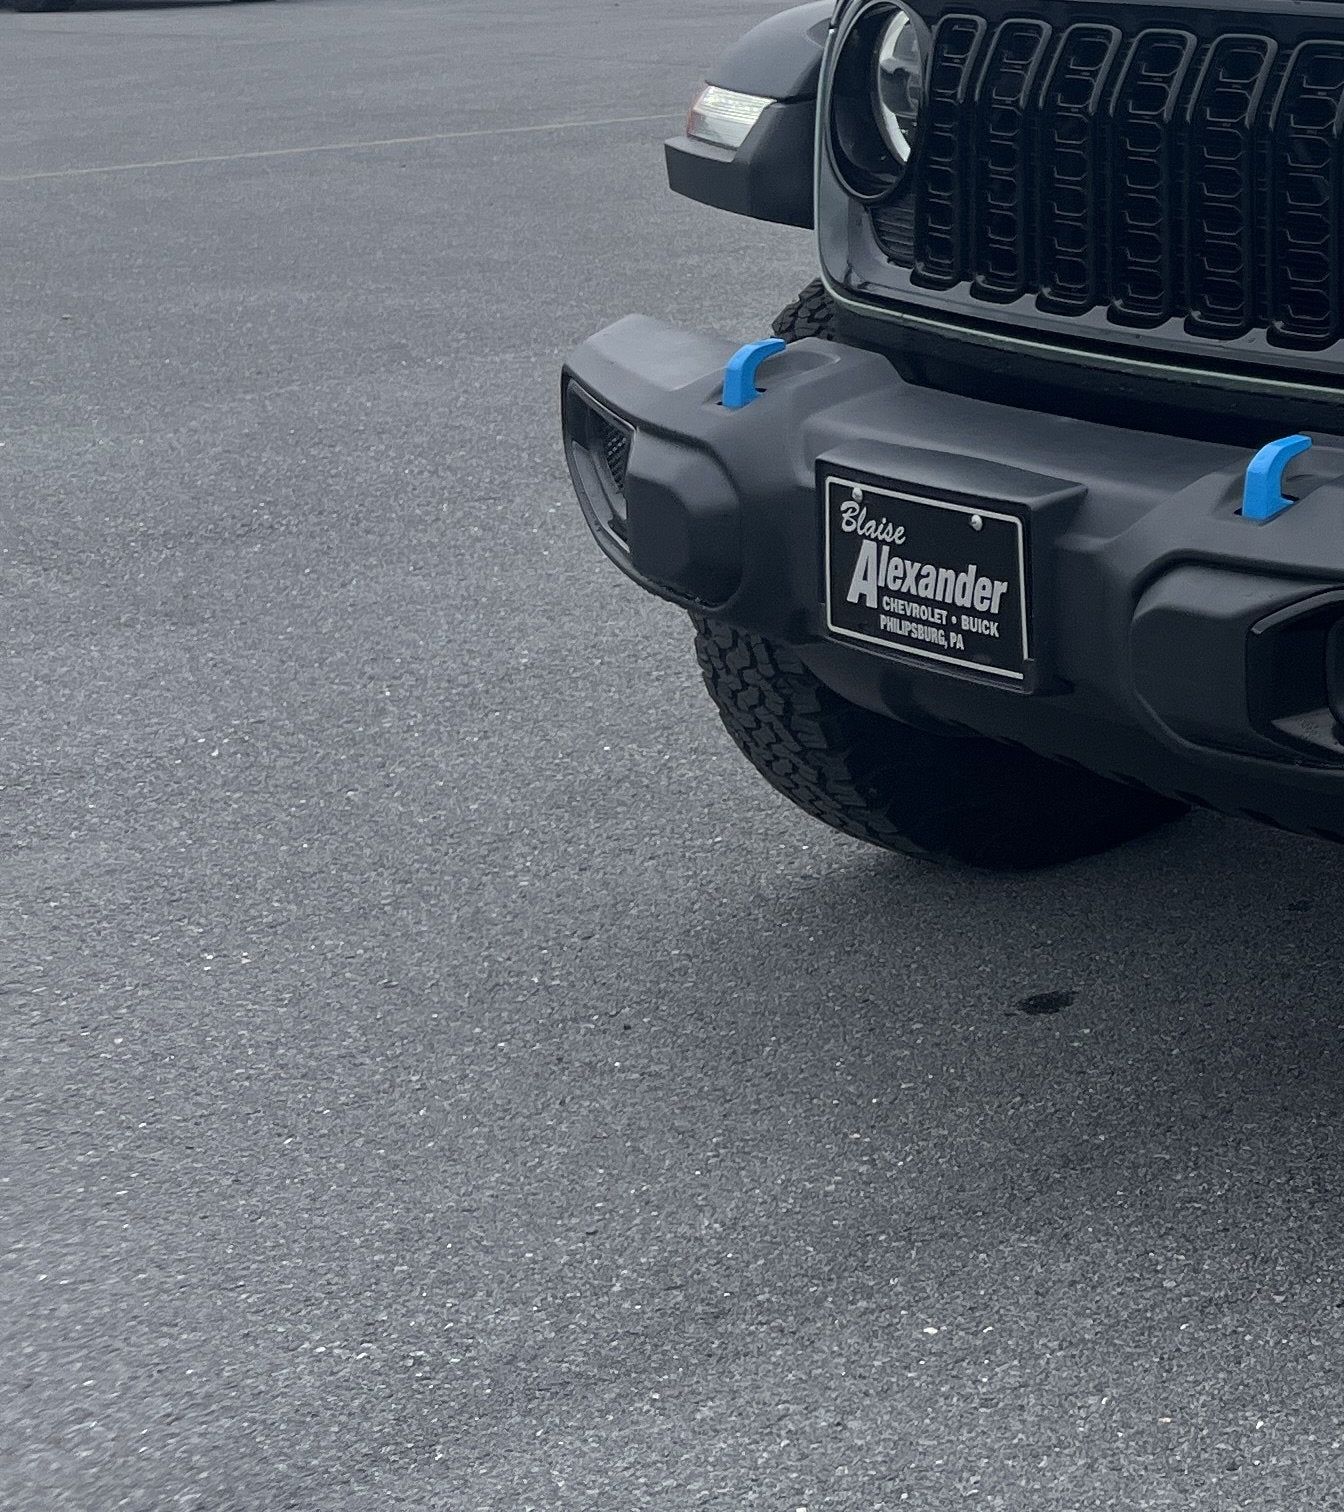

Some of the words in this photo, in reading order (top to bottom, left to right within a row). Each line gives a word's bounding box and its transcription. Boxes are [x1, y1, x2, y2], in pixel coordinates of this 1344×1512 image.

[839, 500, 906, 545] Blaise
[847, 539, 1008, 614] Alexander
[880, 614, 947, 649] PHILIPSBURG,
[949, 632, 965, 651] PA
[882, 596, 947, 625] CHEVROLET
[961, 615, 1000, 638] BUICK
